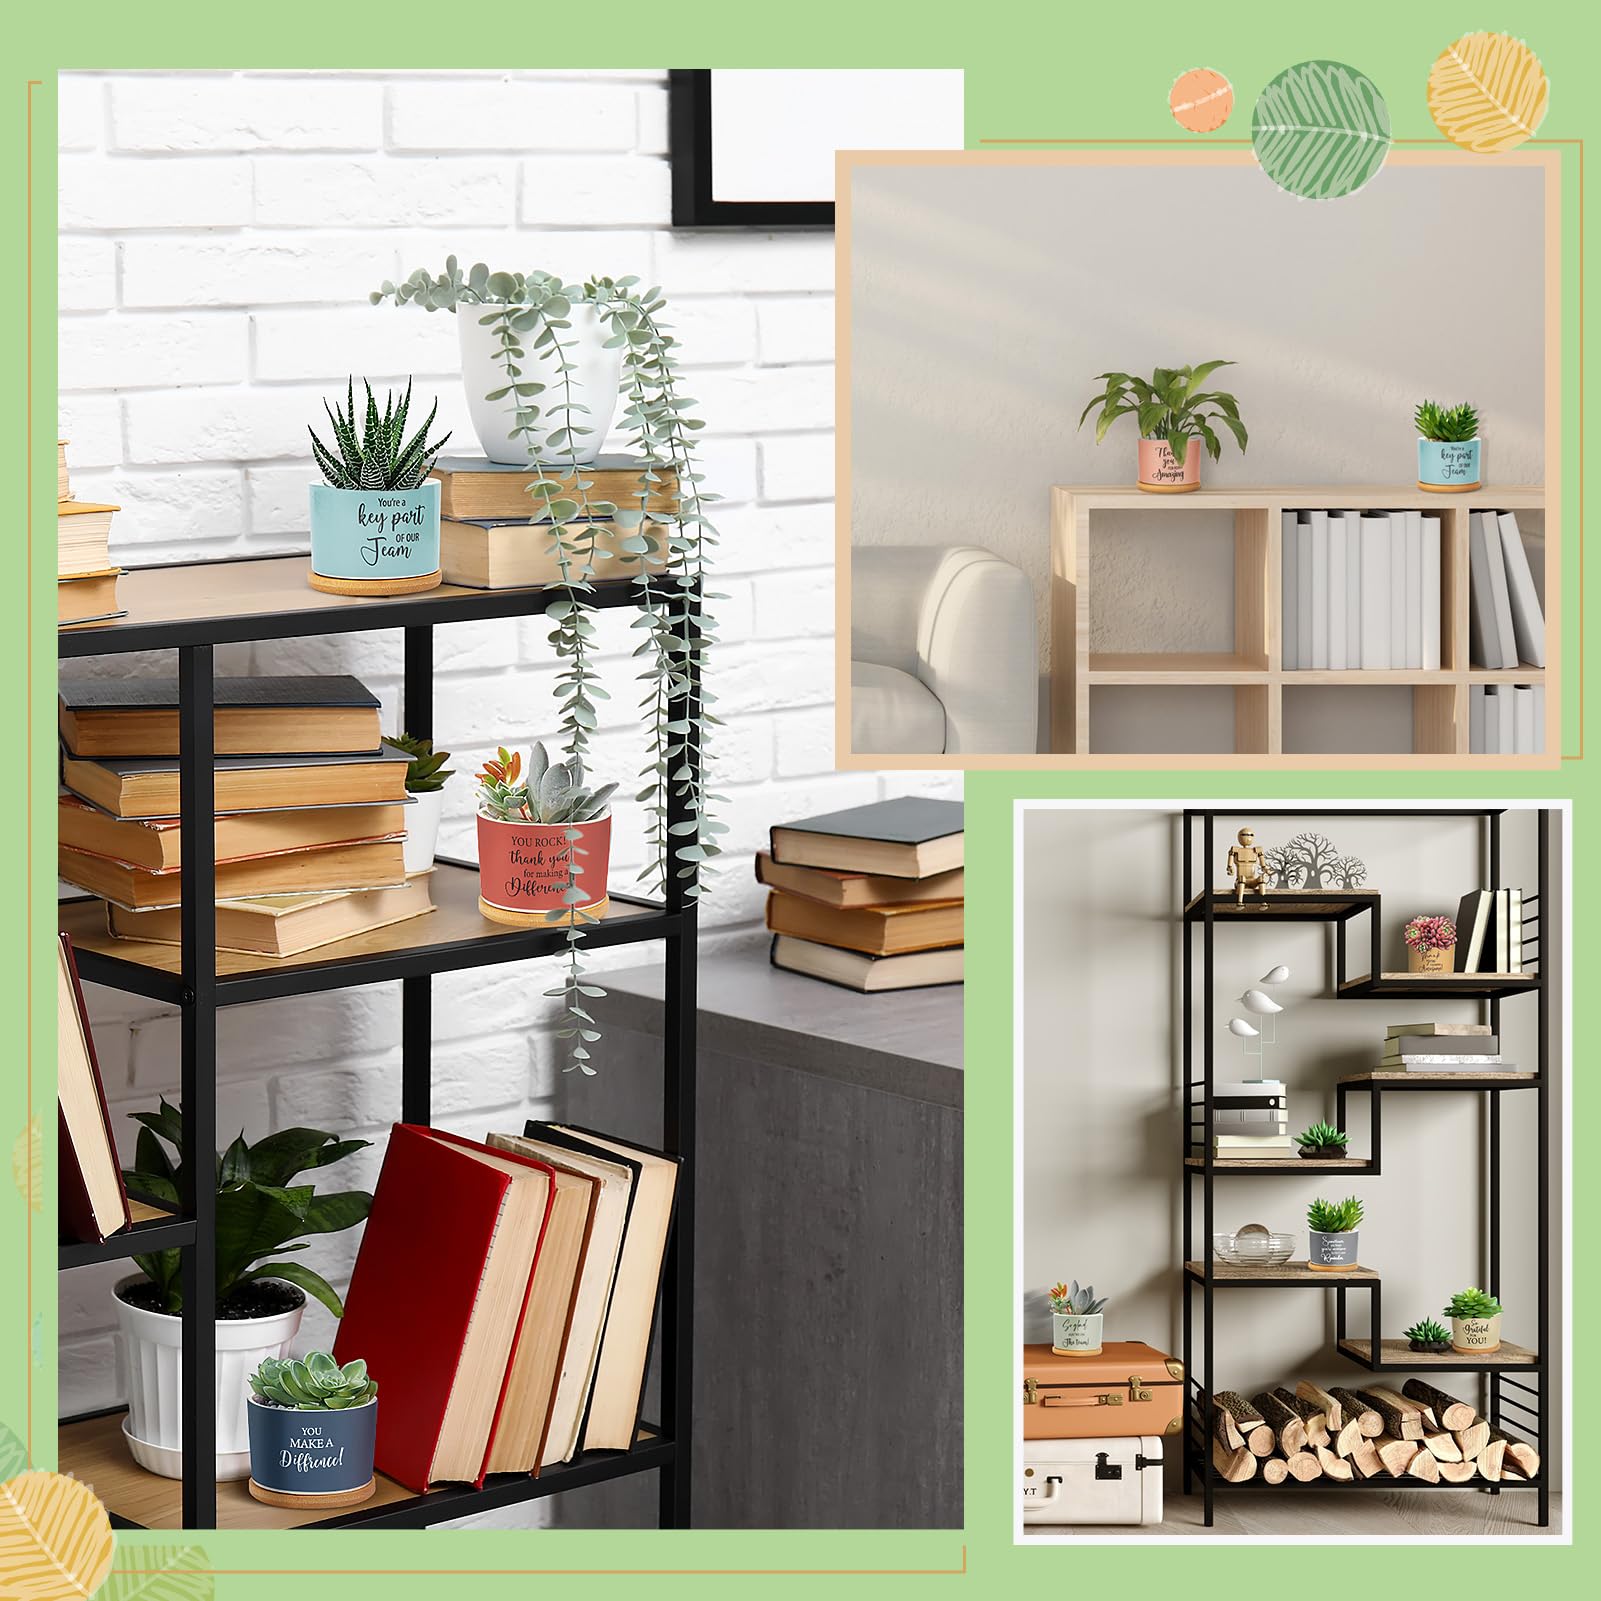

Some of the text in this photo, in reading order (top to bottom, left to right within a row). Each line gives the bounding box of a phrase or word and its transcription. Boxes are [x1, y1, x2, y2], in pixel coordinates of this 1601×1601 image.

[1441, 448, 1456, 463] key
[377, 498, 400, 507] You're
[358, 503, 425, 533] key part
[395, 533, 420, 543] OF OUR
[360, 537, 412, 566] Team
[511, 836, 566, 847] YOU ROCK!
[508, 850, 569, 868] thank you
[523, 868, 534, 878] for
[536, 869, 564, 879] making
[301, 1427, 322, 1436] YOU
[289, 1438, 334, 1449] MAKE A
